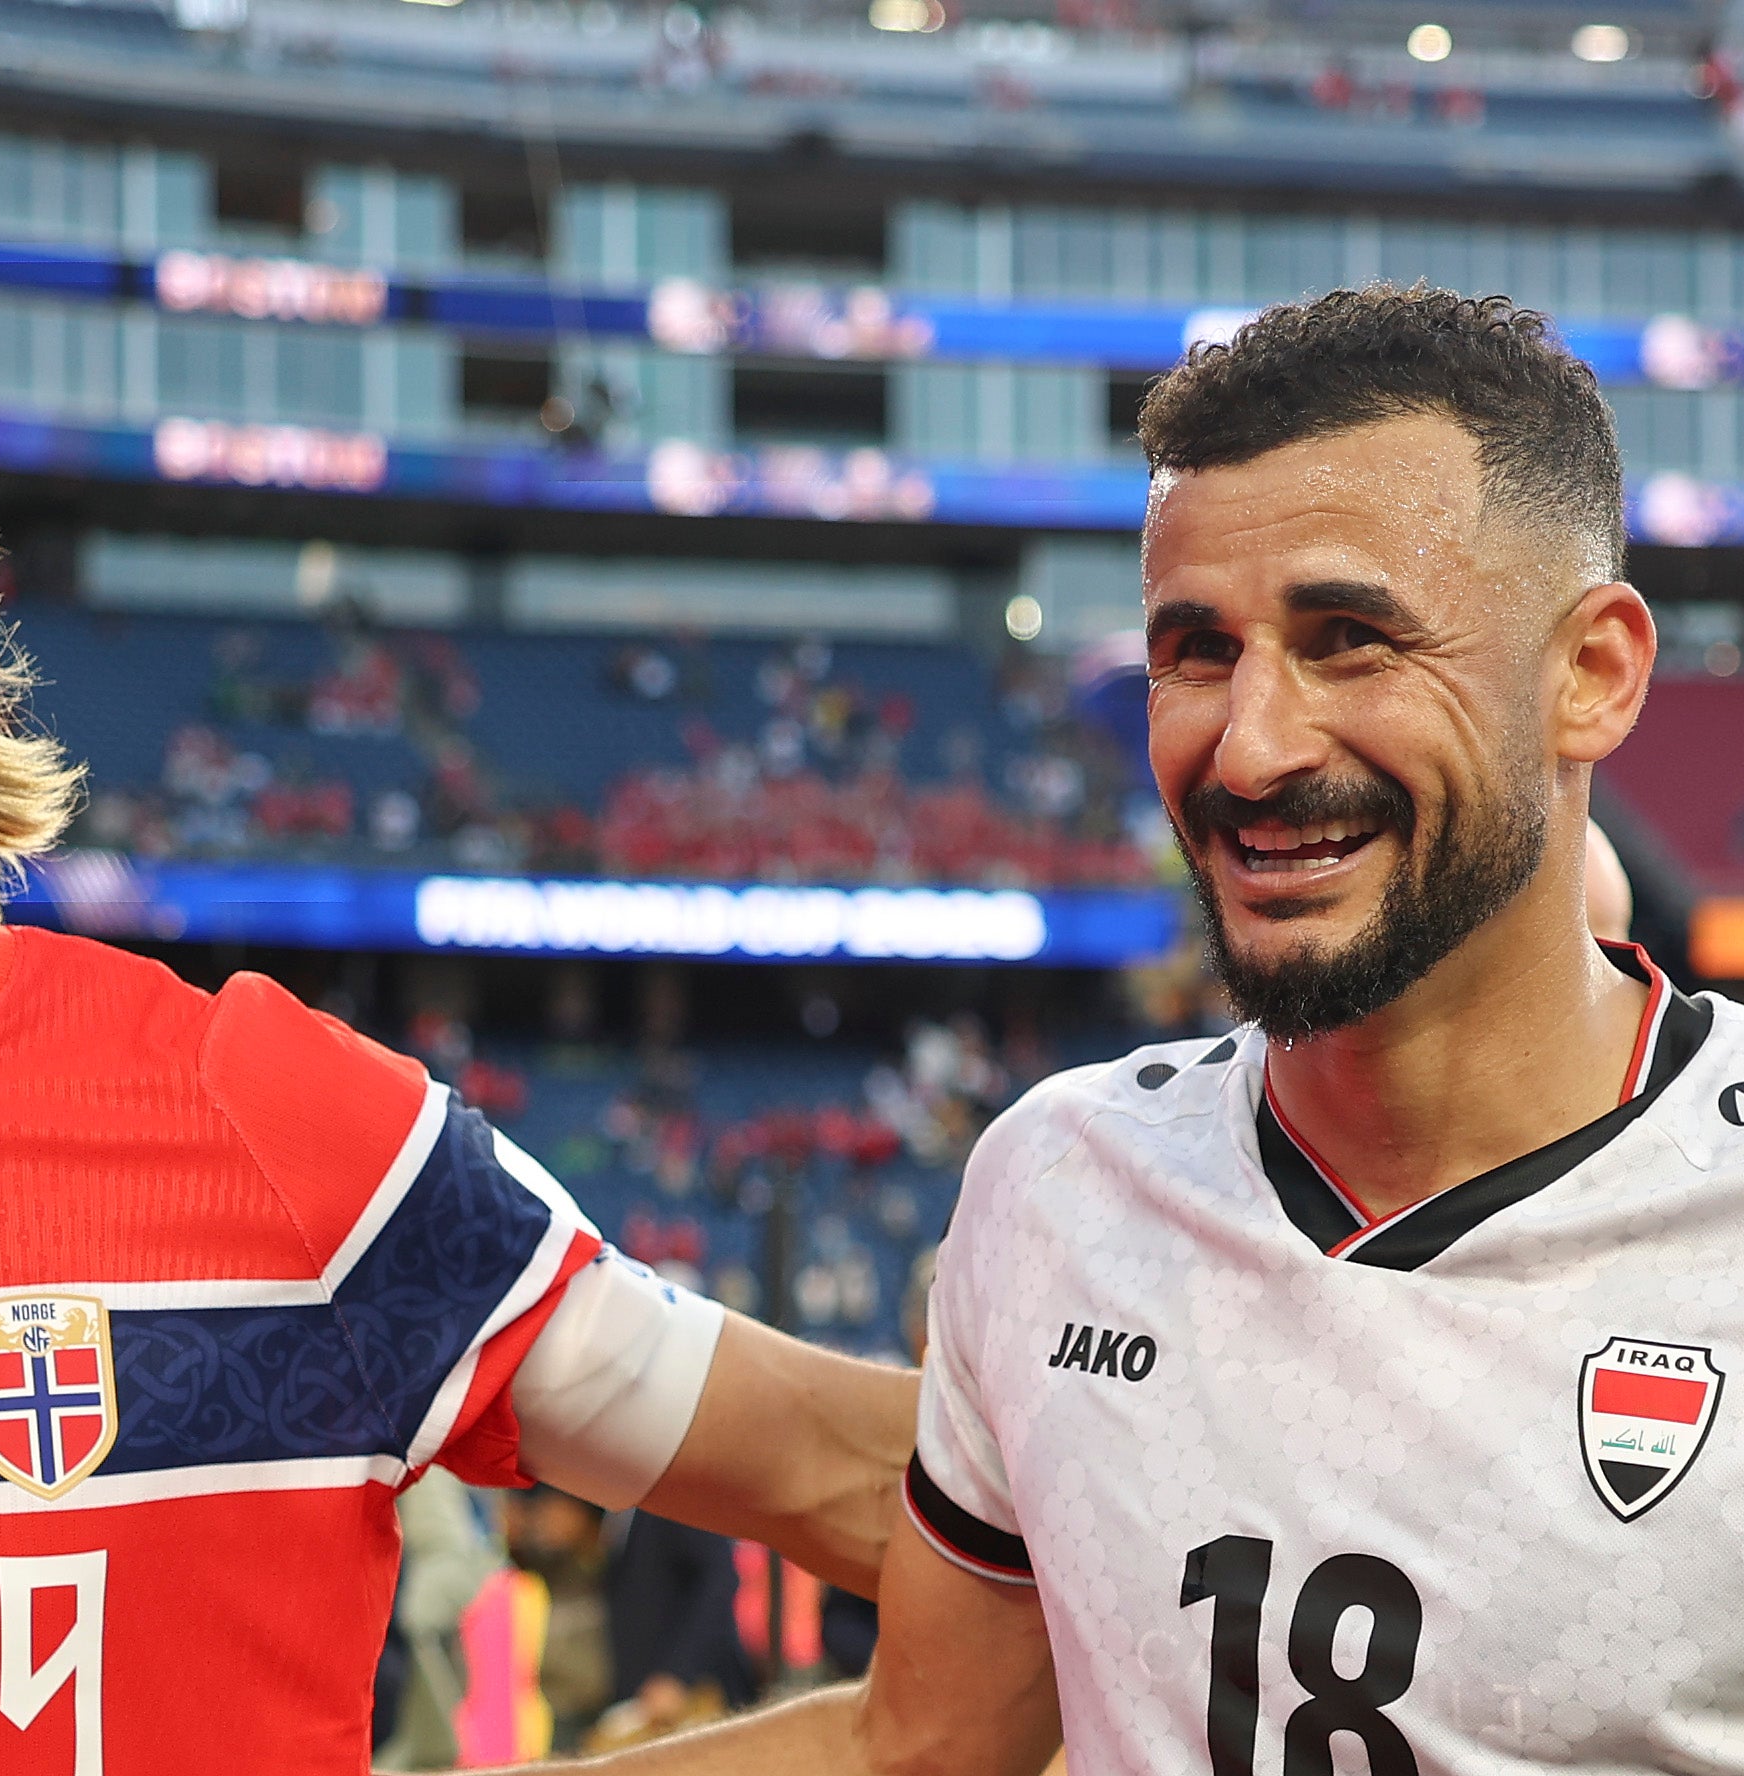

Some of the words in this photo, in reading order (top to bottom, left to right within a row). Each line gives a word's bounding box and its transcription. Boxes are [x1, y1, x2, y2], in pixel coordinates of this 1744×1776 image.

[12, 1303, 57, 1322] NORGE
[1048, 1323, 1158, 1382] JAKO
[1617, 1348, 1695, 1374] IRAQ
